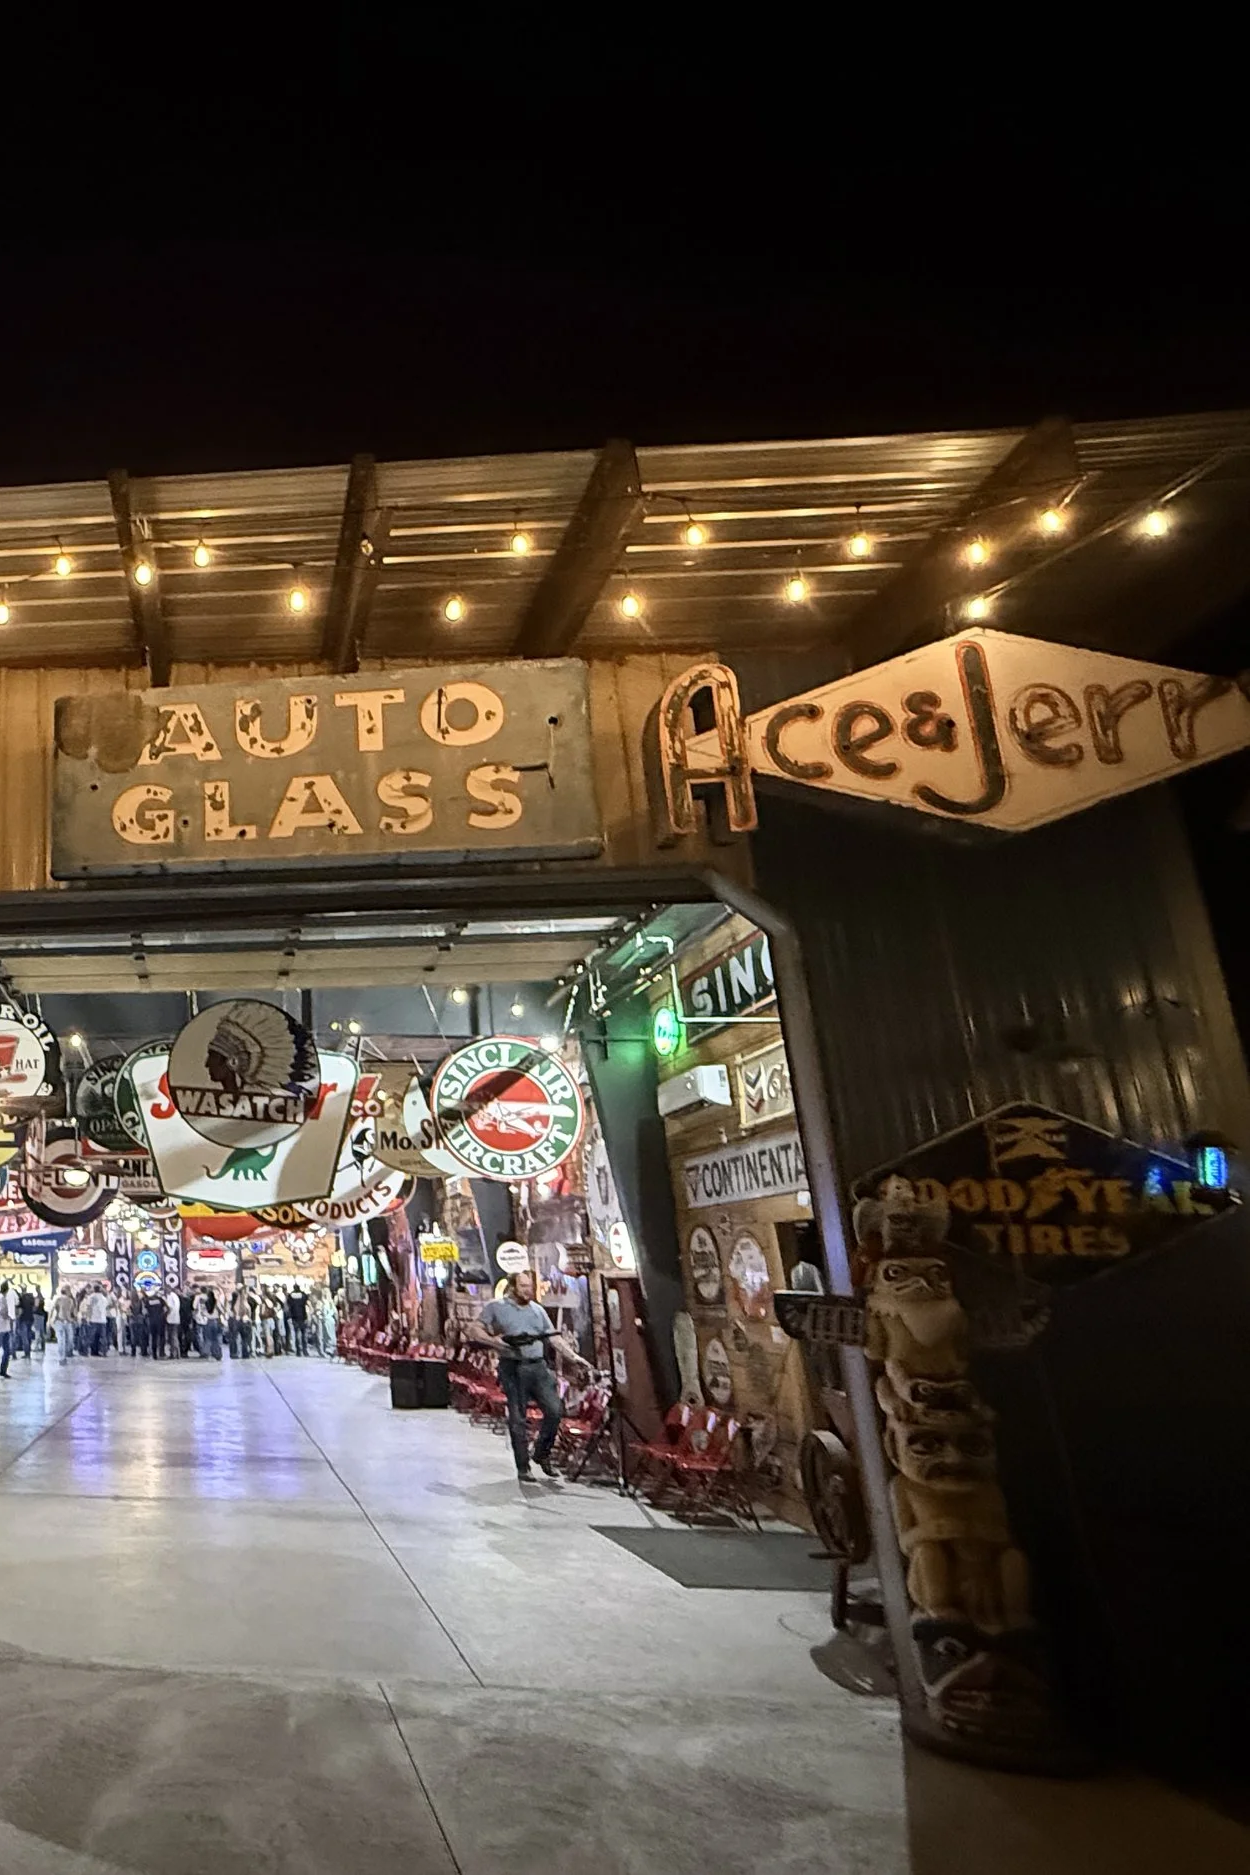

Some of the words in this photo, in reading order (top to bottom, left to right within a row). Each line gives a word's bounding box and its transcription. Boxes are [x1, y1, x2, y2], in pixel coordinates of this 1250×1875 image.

[138, 681, 504, 766] AUTO
[660, 641, 1249, 833] Ace&Jerr
[112, 764, 524, 844] GLASS
[22, 1012, 55, 1052] OIL
[16, 1058, 40, 1071] HAT
[175, 1089, 305, 1123] WASATCH
[973, 1224, 1130, 1256] TIRES
